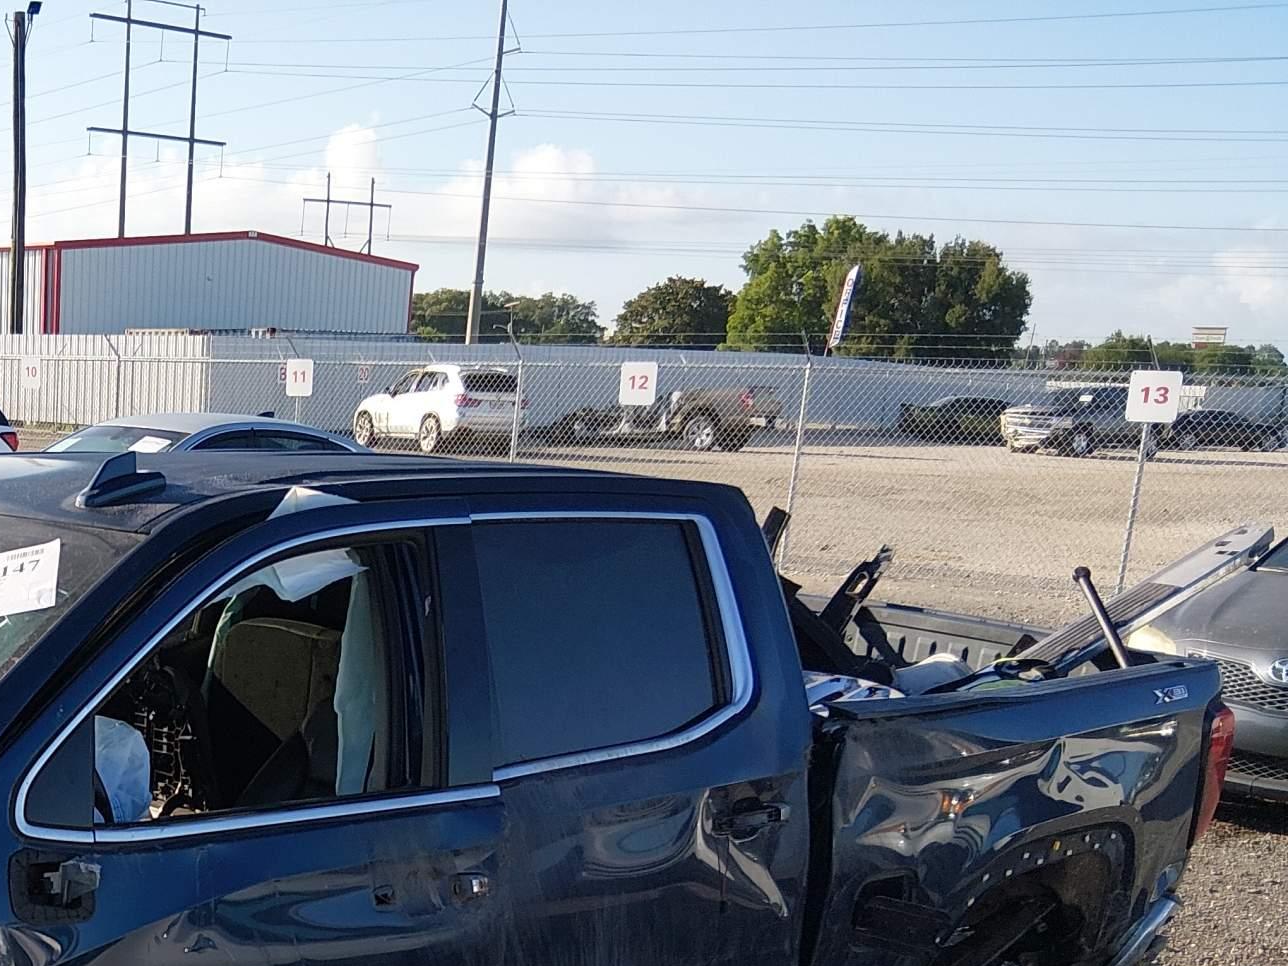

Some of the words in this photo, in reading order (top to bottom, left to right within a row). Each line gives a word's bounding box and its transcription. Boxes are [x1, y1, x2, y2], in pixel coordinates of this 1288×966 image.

[25, 366, 37, 378] 10
[292, 370, 306, 383] 11
[629, 374, 649, 390] 12
[1141, 386, 1169, 404] 13
